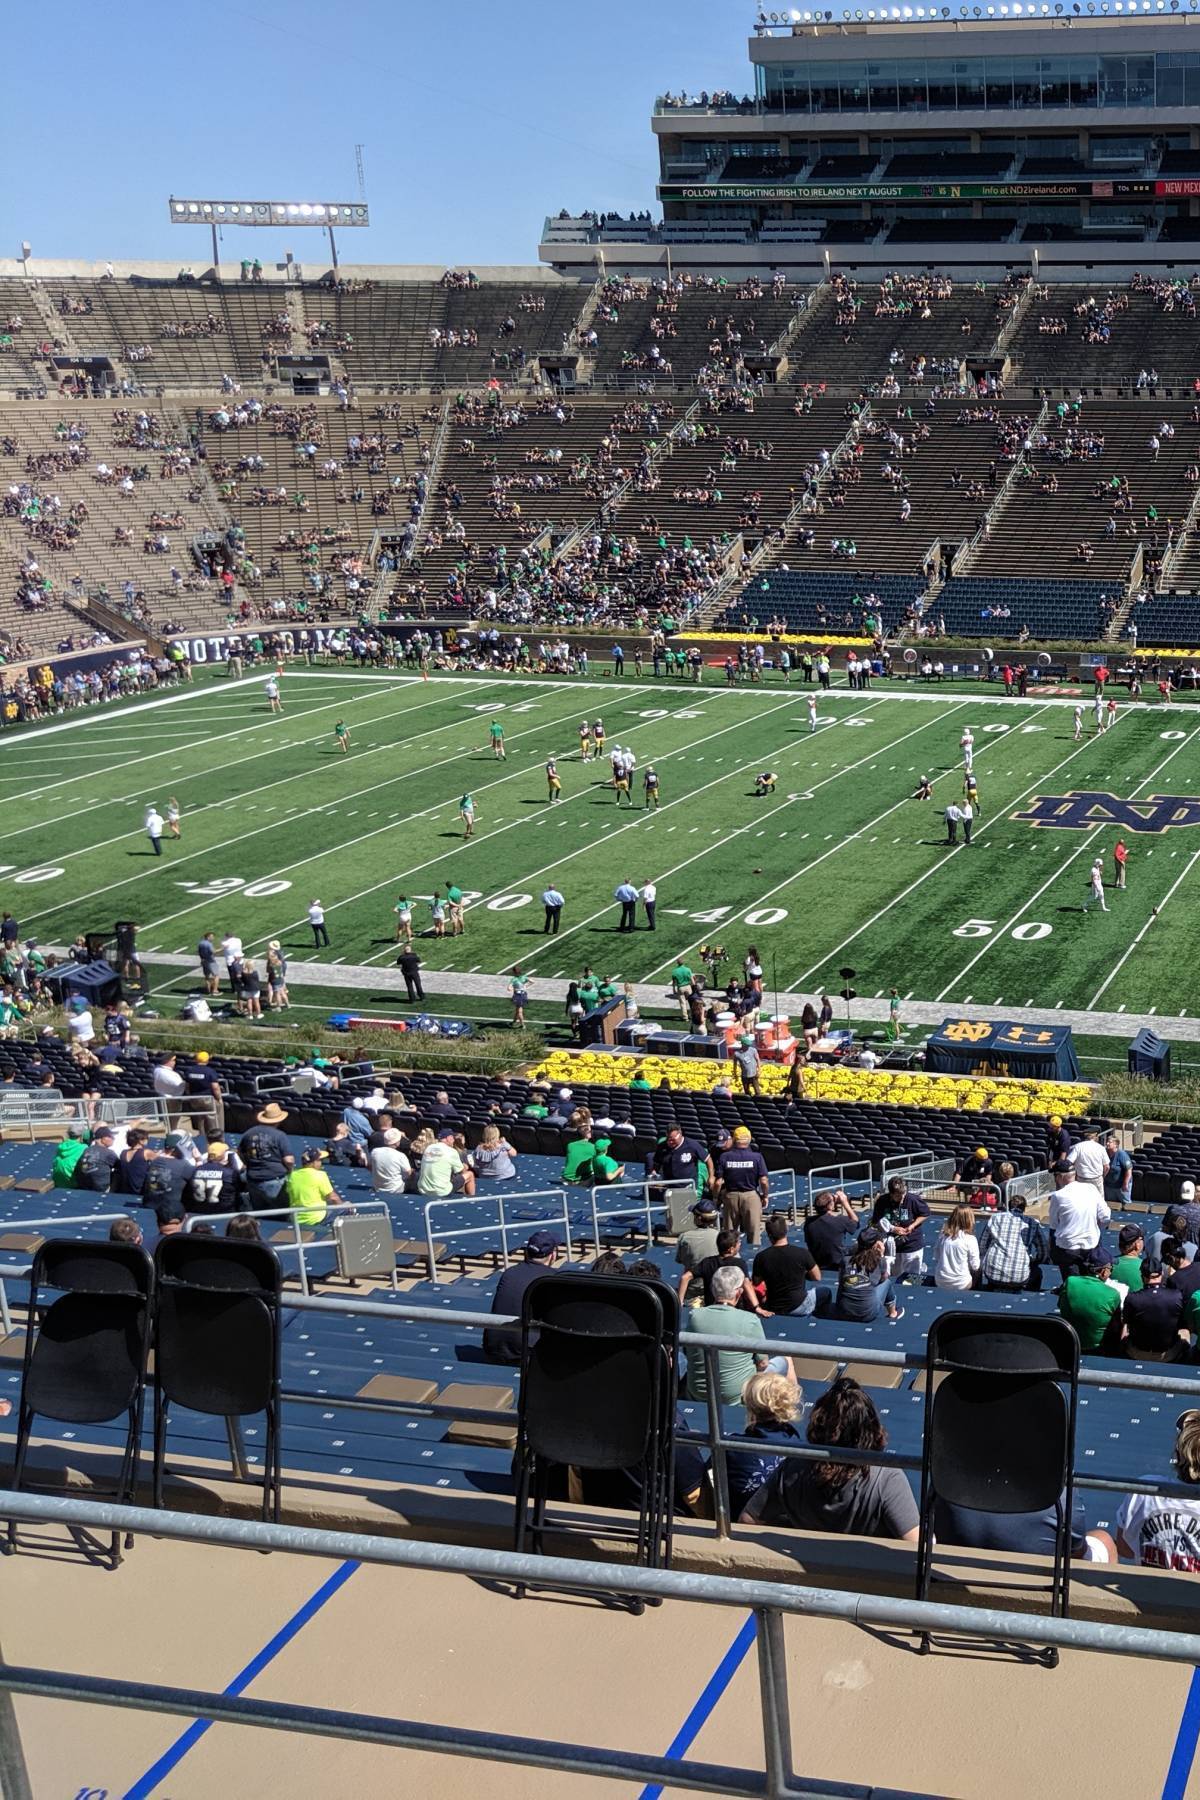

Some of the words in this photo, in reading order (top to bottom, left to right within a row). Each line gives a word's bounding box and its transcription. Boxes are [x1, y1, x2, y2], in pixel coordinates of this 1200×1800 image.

[682, 189, 717, 198] FOLLOW
[719, 188, 735, 198] THE
[737, 188, 776, 197] FIGHTING
[777, 188, 797, 197] IRISH
[798, 188, 810, 197] TO
[811, 188, 846, 197] IRELAND
[847, 187, 868, 196] NEXT
[869, 187, 903, 196] AUGUST
[982, 186, 998, 194] Info
[1000, 186, 1009, 194] at
[1165, 182, 1183, 193] NEW
[1141, 1512, 1182, 1540] NOTRE
[1173, 1534, 1186, 1552] VS
